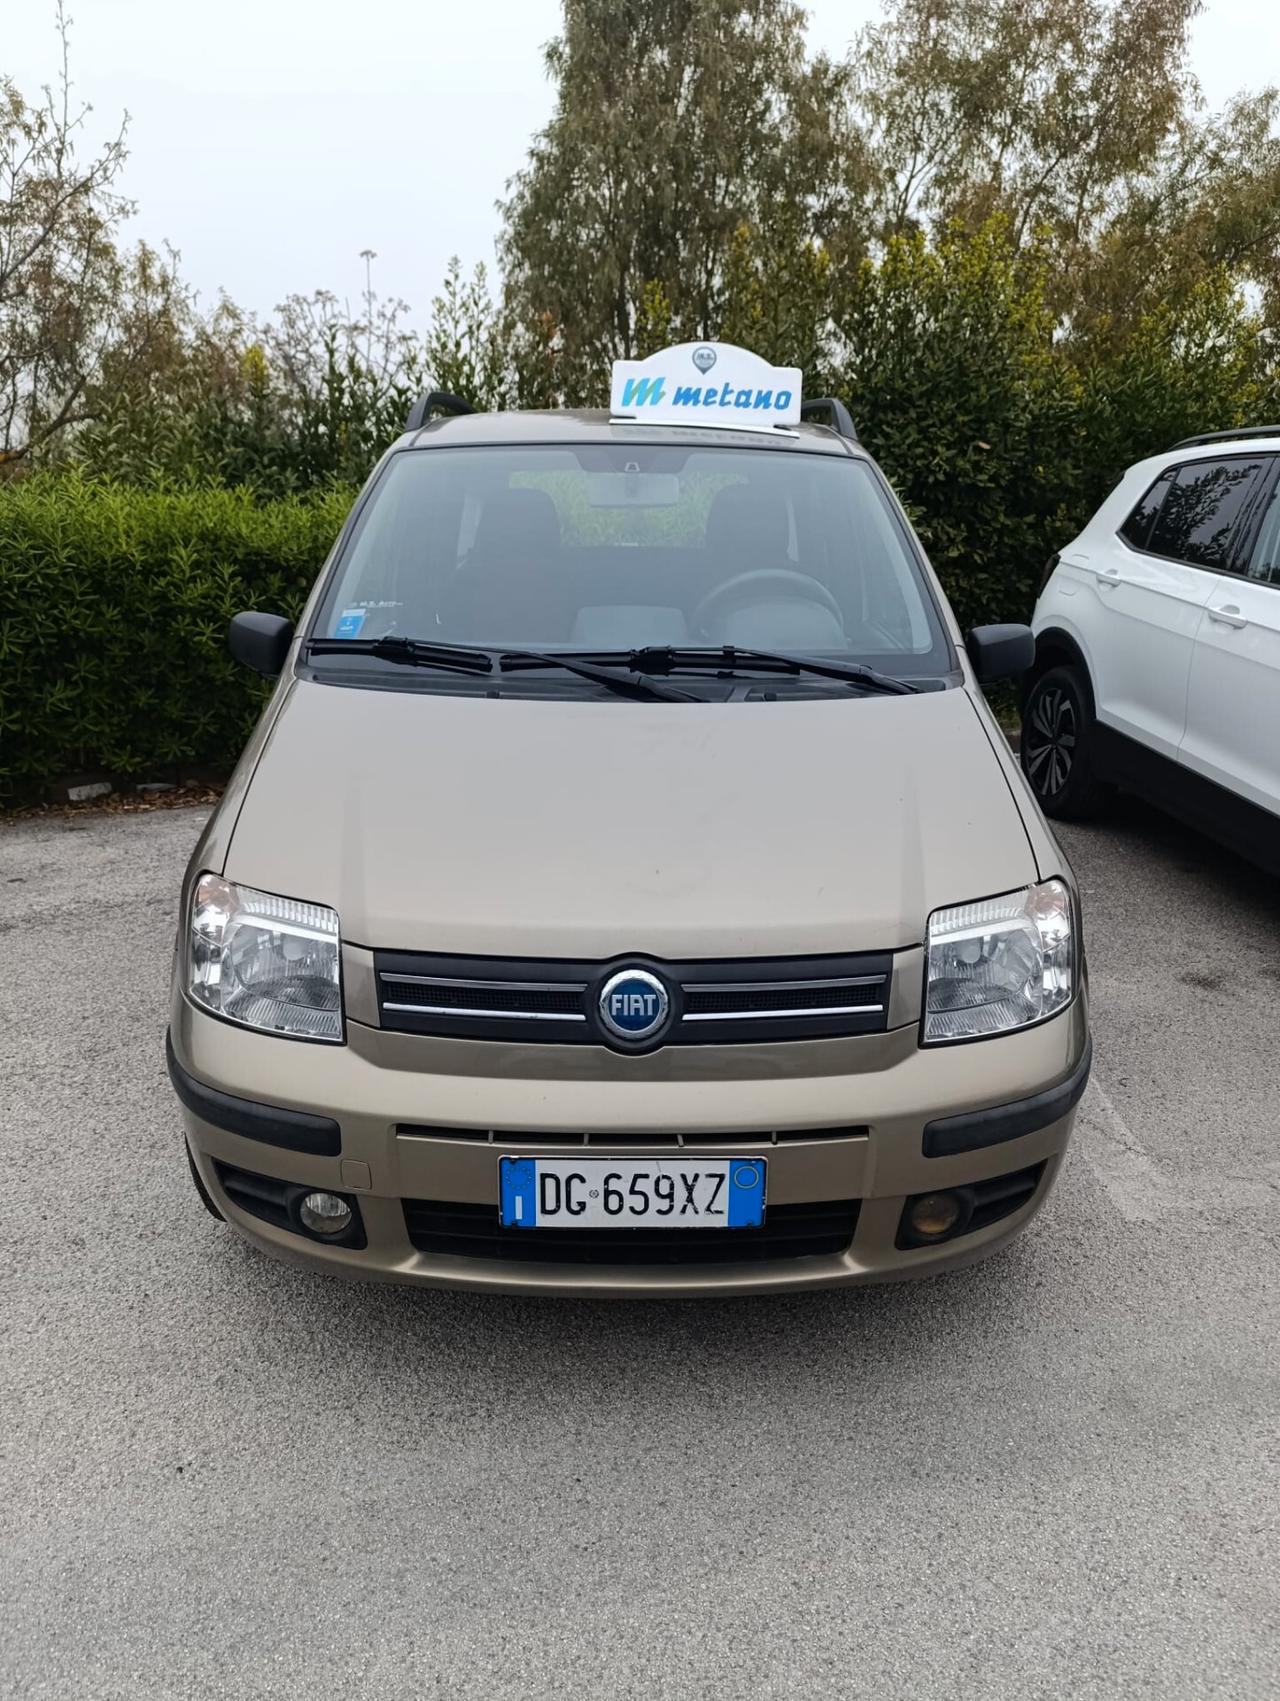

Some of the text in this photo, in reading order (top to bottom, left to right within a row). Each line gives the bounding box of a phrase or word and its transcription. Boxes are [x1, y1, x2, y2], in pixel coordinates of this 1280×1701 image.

[672, 382, 793, 411] metano
[611, 994, 657, 1016] FIAT
[539, 1172, 587, 1216] DG
[603, 1172, 726, 1216] 659XZ
